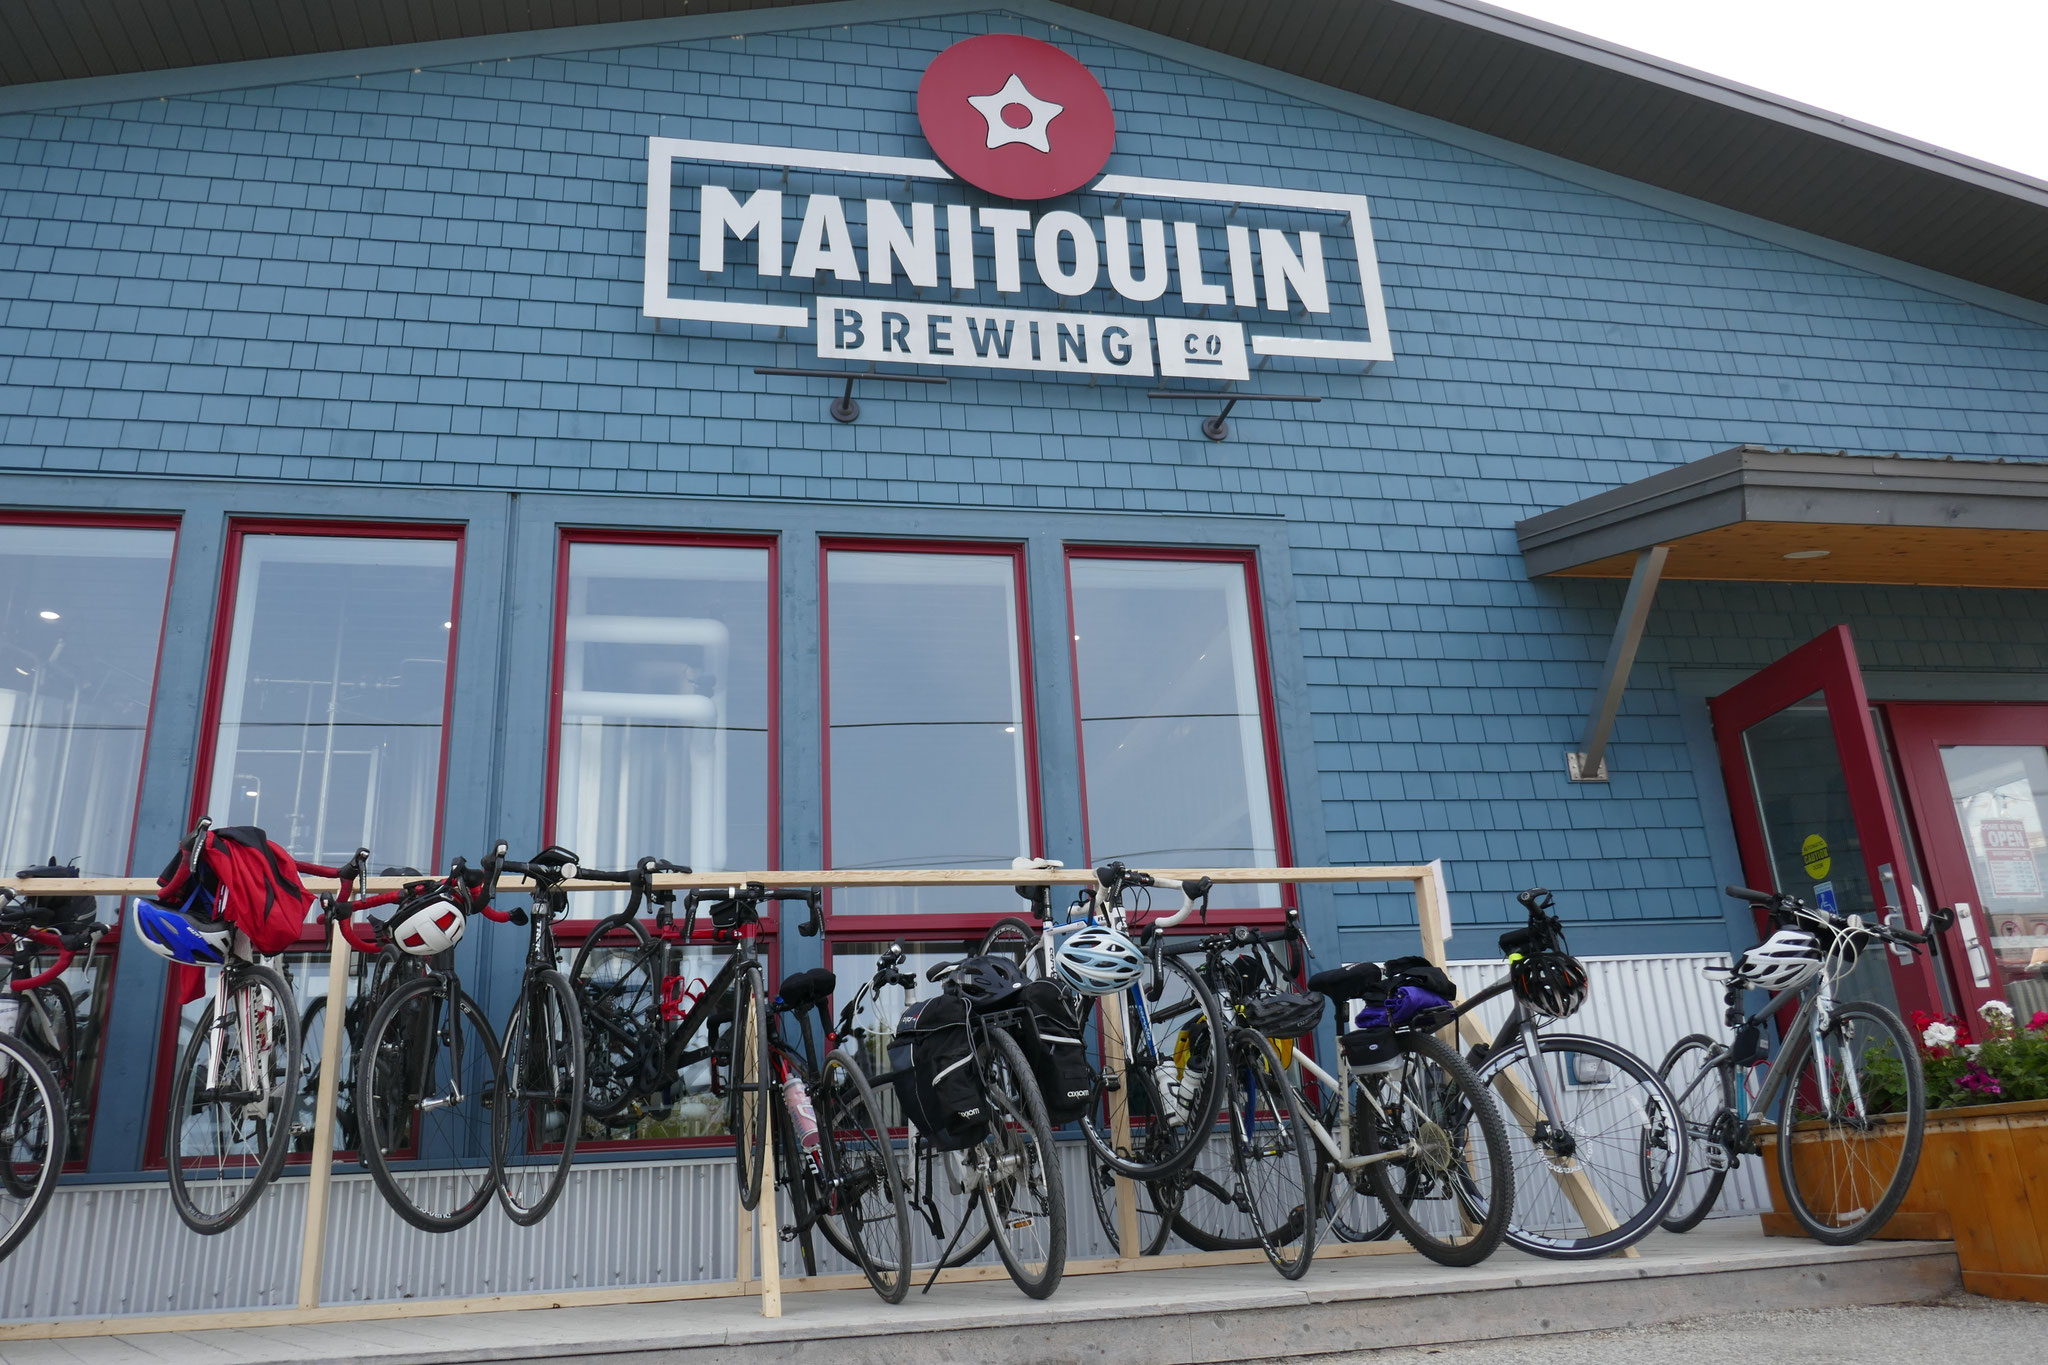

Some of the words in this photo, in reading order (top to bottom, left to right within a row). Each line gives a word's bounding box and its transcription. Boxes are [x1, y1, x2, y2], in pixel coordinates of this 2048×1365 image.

[699, 185, 1330, 314] MANITOULIN
[834, 308, 1133, 366] BREWING
[1184, 333, 1222, 356] CO
[1988, 831, 2025, 848] OPEN
